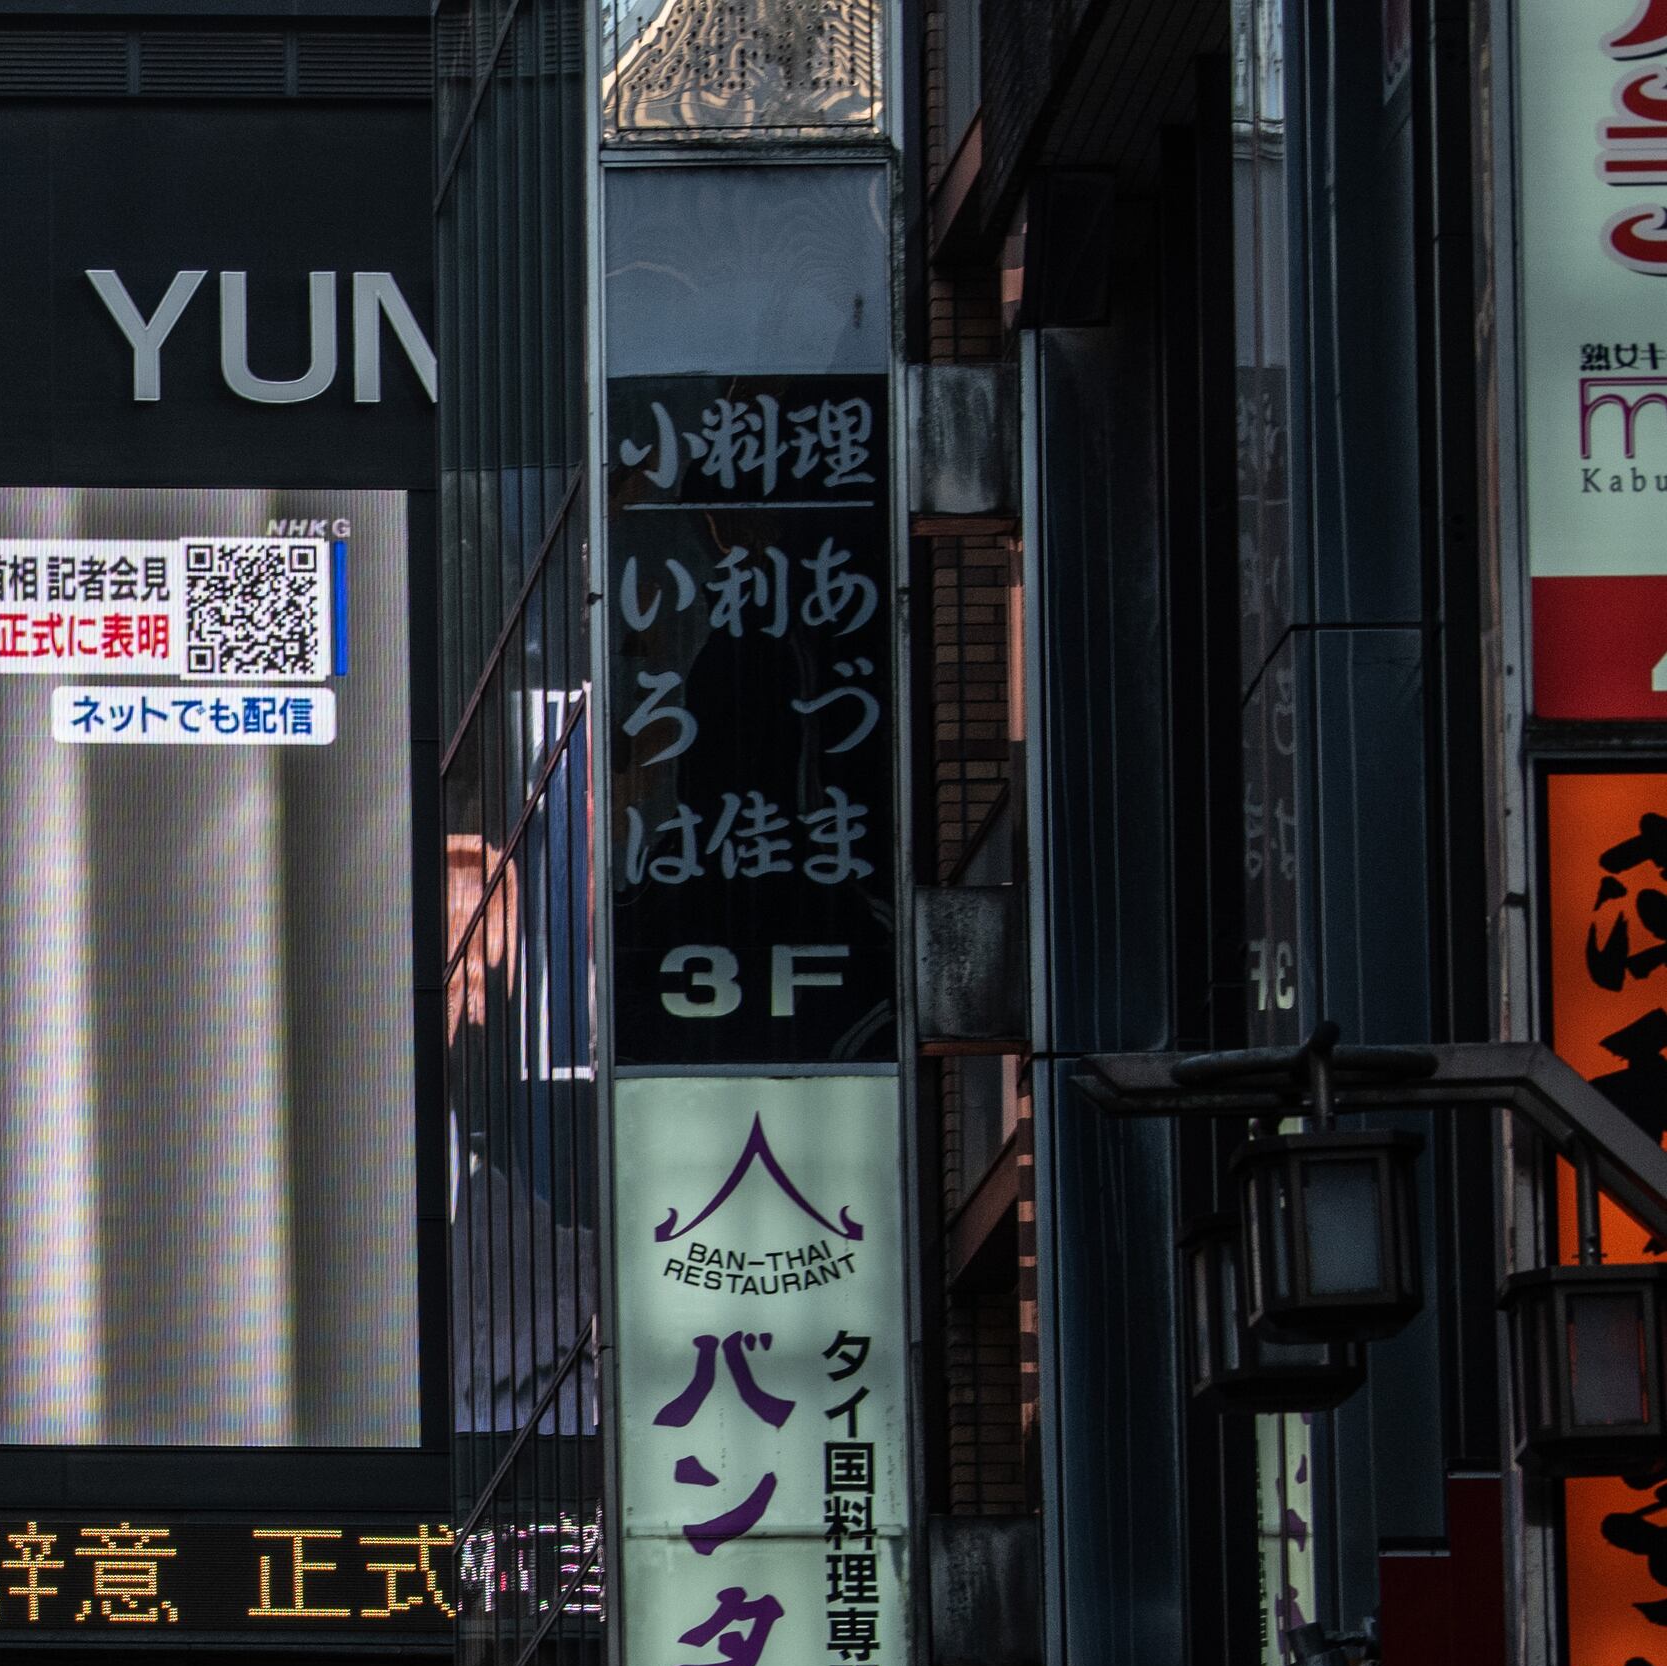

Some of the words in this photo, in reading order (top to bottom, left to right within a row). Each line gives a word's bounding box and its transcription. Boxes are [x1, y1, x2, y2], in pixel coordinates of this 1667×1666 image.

[619, 393, 877, 498] 小料理
[267, 519, 327, 538] NHK
[45, 554, 171, 604] 記者会見
[70, 696, 314, 737] ネットでも配信
[657, 942, 852, 1019] 3F
[663, 1255, 862, 1298] RESTAURANT
[686, 1240, 833, 1273] BAN-THAI
